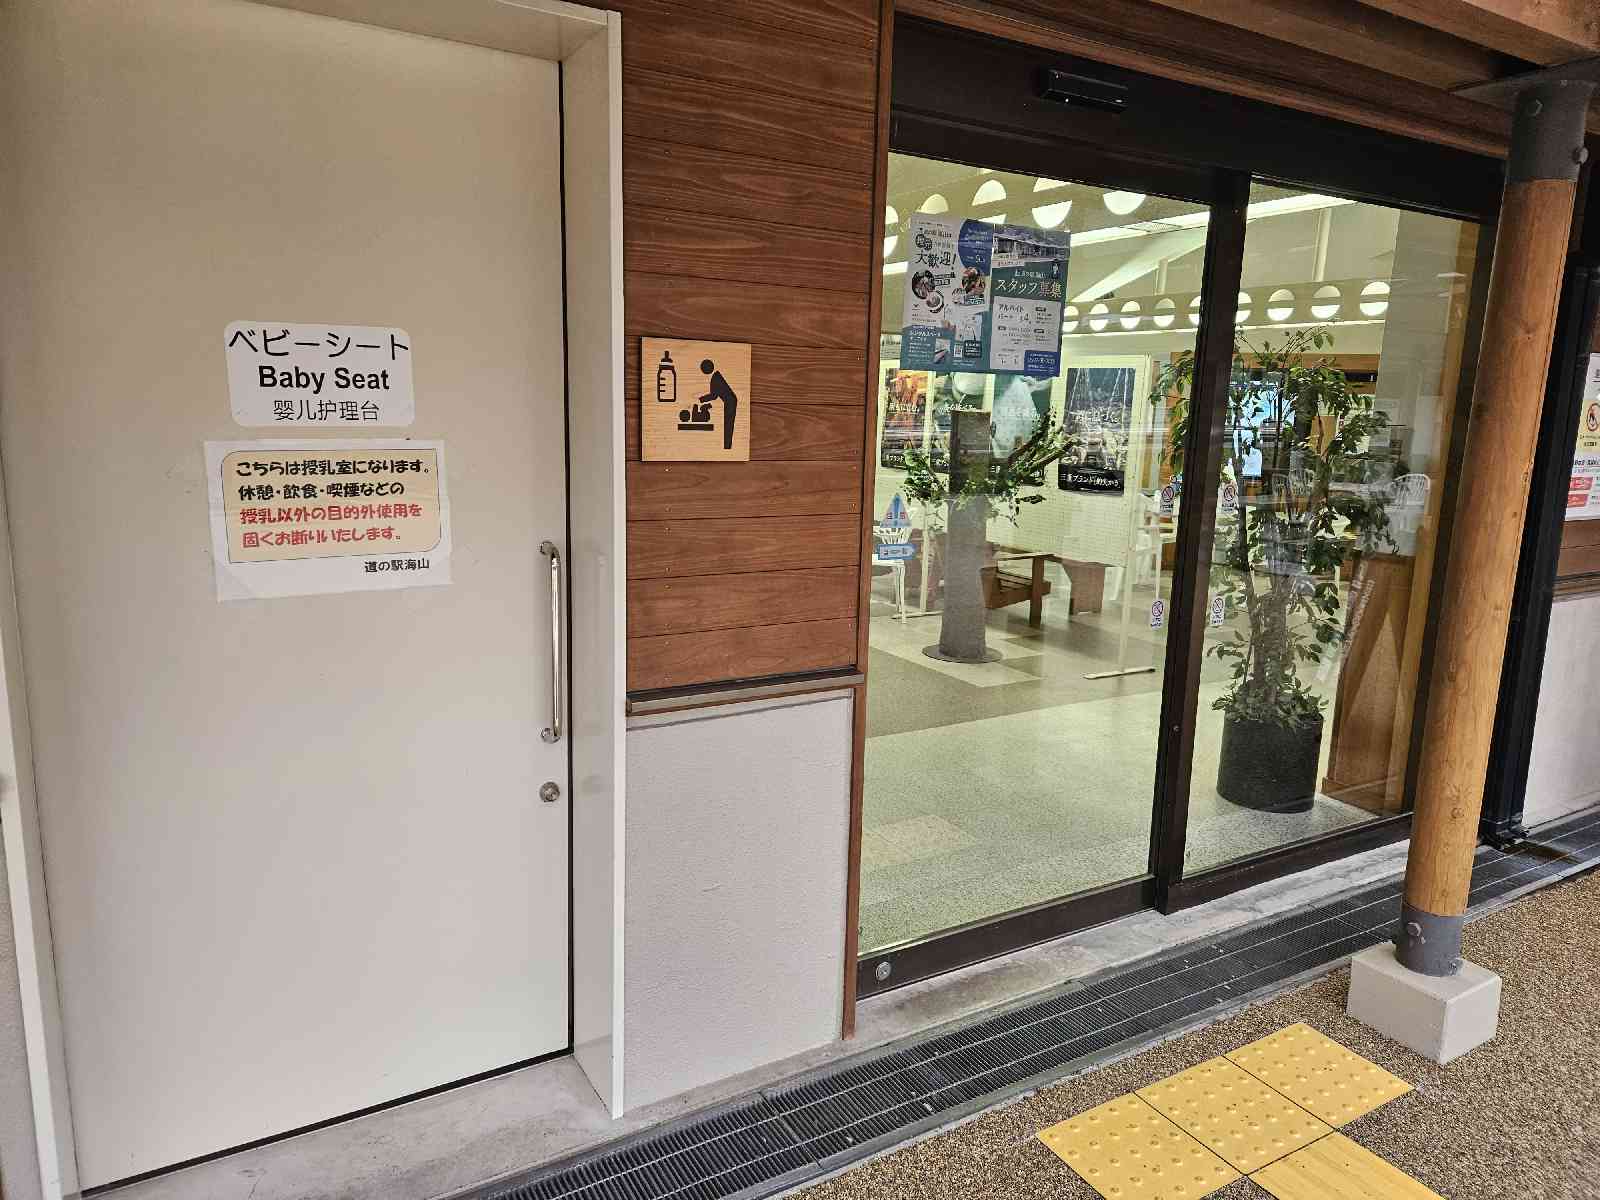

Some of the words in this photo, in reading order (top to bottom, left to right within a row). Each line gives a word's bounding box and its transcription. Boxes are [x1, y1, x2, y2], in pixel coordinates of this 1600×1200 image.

[995, 278, 1062, 298] スタッフ募集
[228, 329, 409, 360] ベビーシート
[258, 365, 325, 394] Baby
[334, 367, 390, 390] Seat
[273, 400, 380, 421] 婴儿护理台
[235, 459, 430, 477] こちらは授乳室になります。
[239, 503, 423, 524] 授乳以外の目的外使用を
[242, 526, 402, 548] 固くお断りいたします。
[364, 558, 430, 573] 道の駅海山
